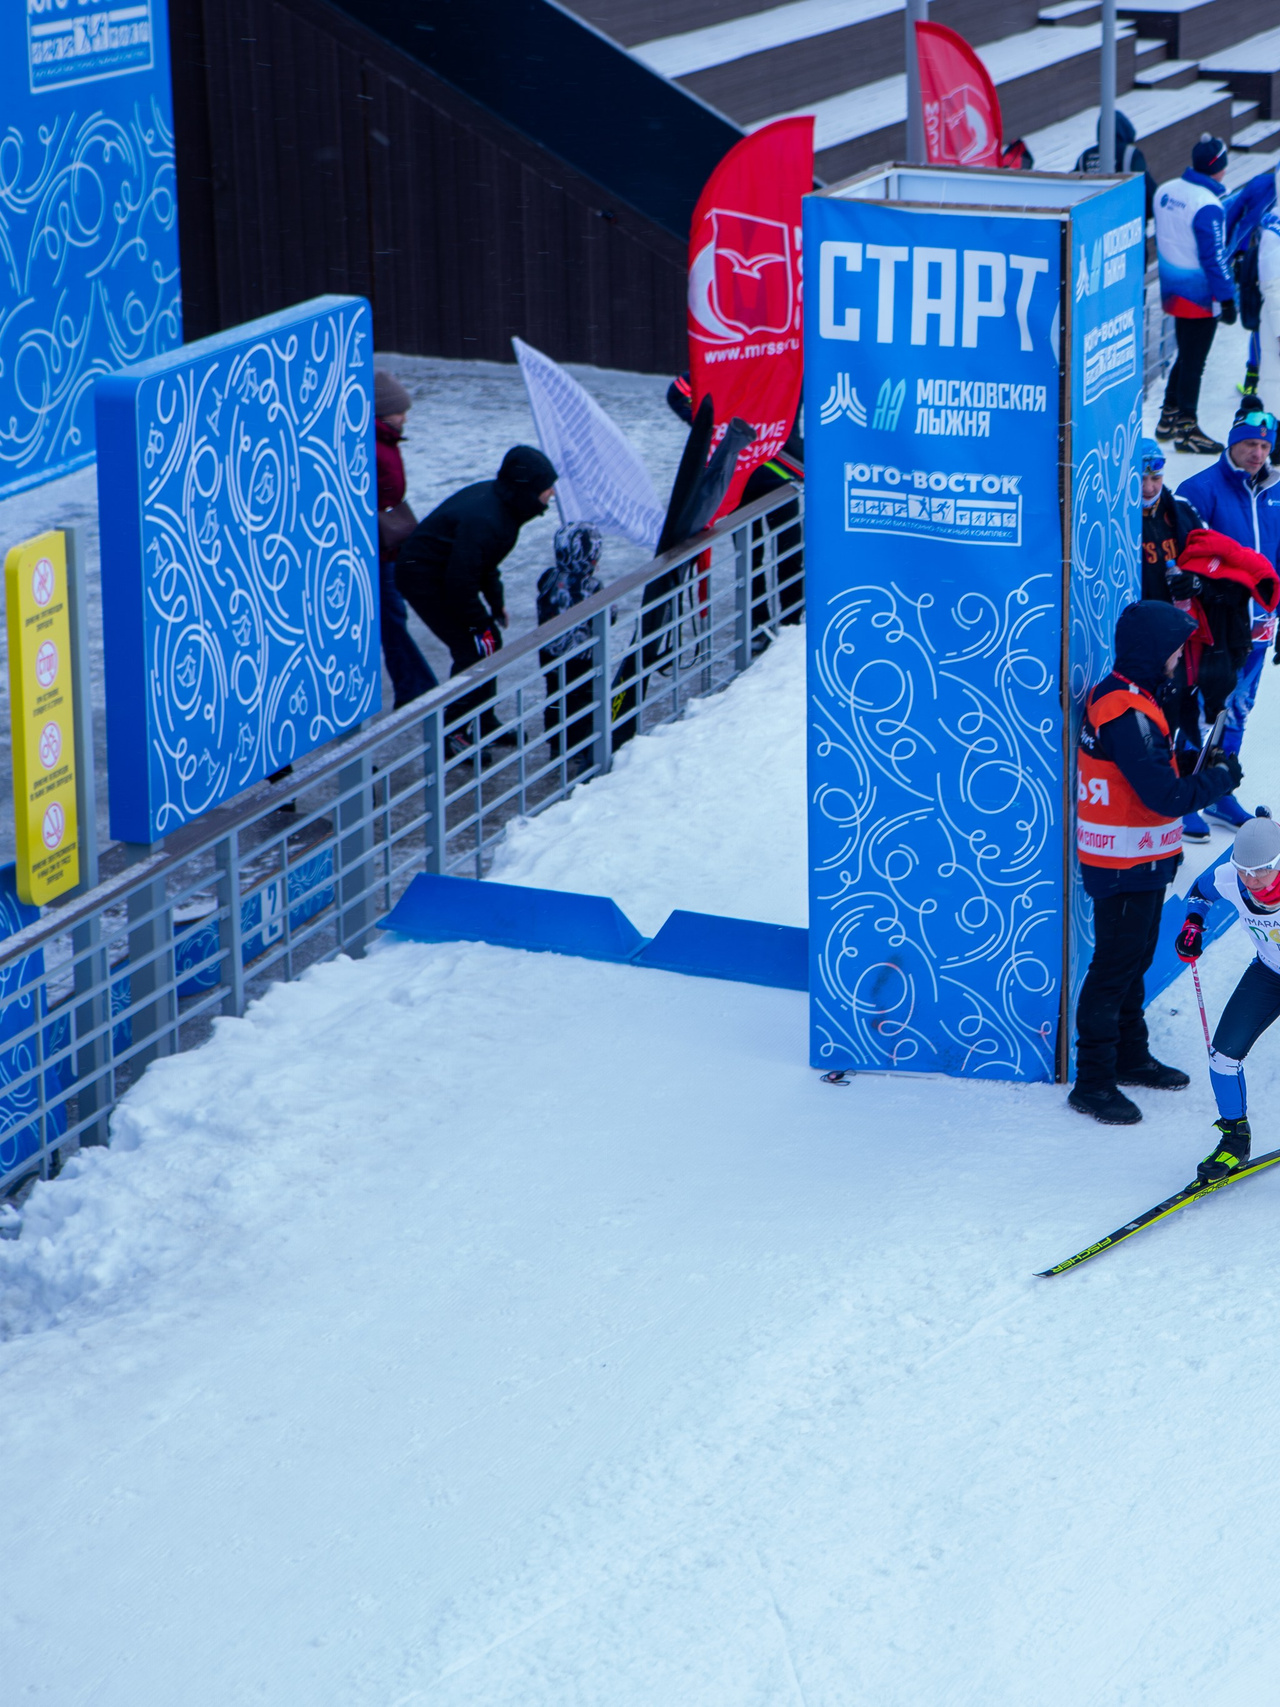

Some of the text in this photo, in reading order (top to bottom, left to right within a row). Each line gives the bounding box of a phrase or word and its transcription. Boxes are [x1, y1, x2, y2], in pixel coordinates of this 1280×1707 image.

[818, 240, 1049, 352] СТАРТ
[704, 338, 800, 365] www.mrssru
[915, 377, 1047, 413] МОСКОВСКАЯ
[914, 407, 991, 438] ЛЫЖНЯ
[844, 462, 1023, 496] ЮГО-ВОСТОК
[1192, 1178, 1230, 1201] FISCHER
[1051, 1236, 1113, 1274] FISCHER
